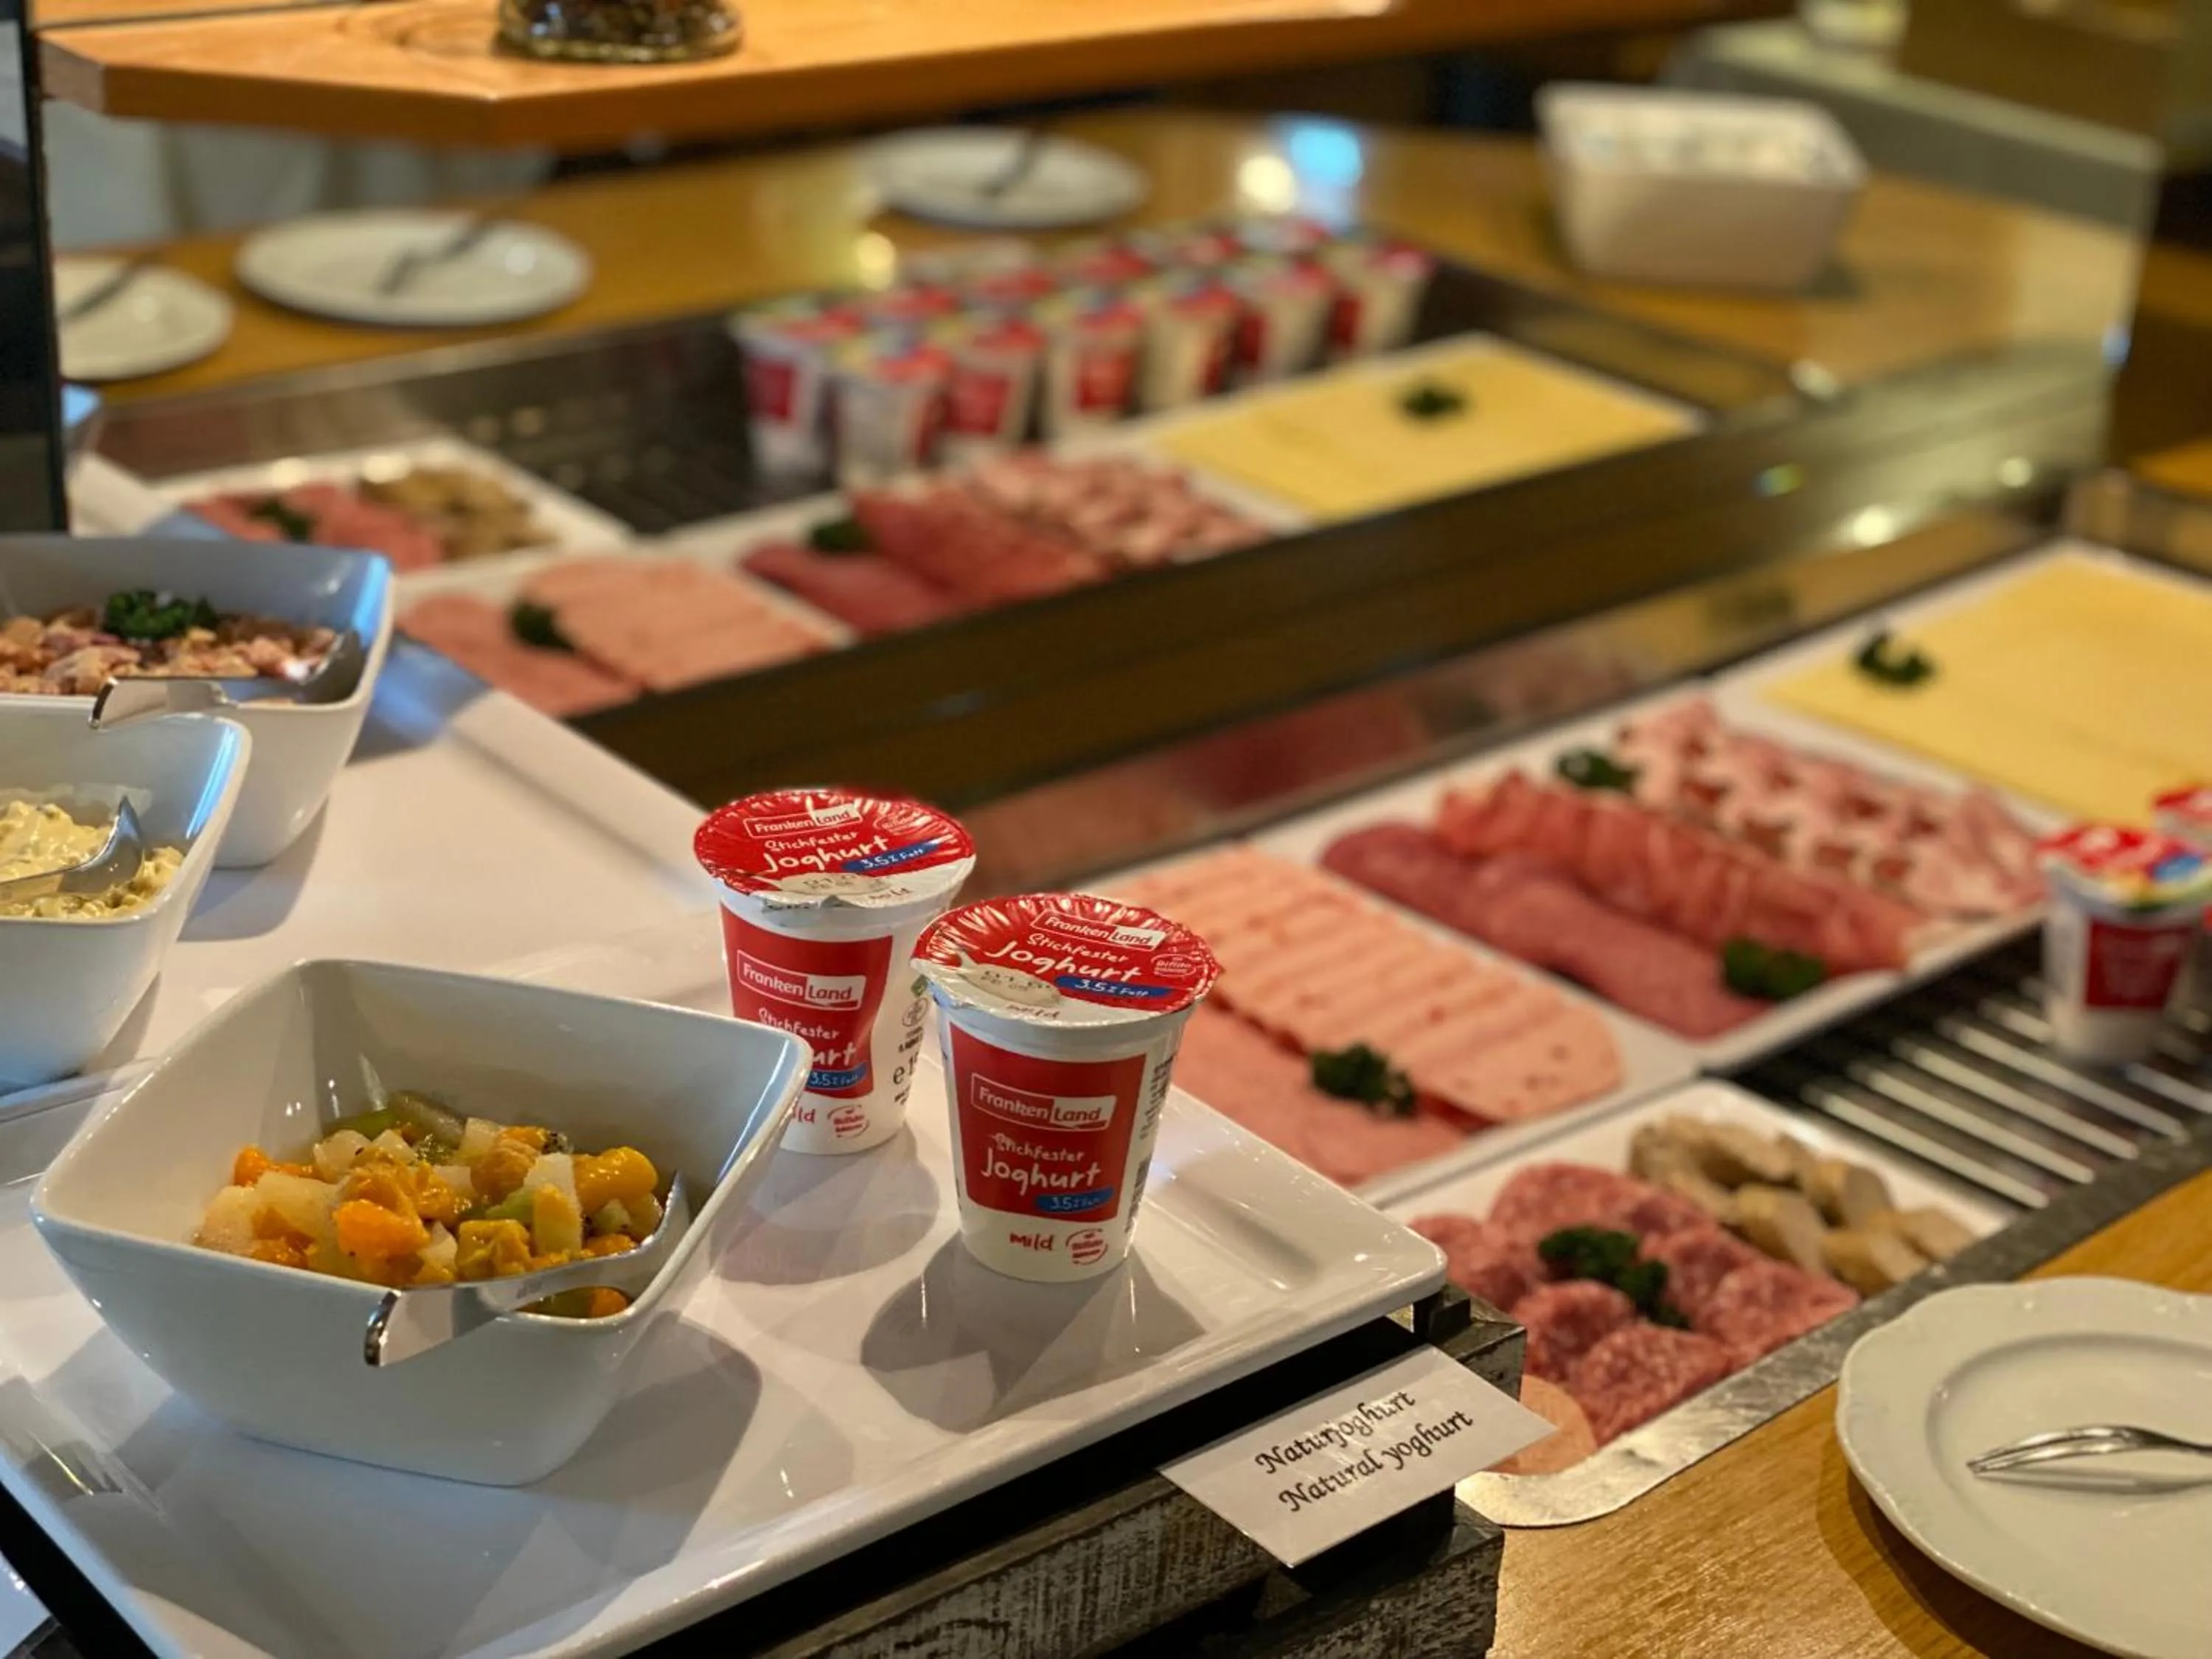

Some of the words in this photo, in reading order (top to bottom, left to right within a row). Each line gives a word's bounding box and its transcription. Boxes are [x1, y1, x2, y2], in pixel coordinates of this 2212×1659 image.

[762, 835, 889, 873] Joghurt
[765, 831, 859, 852] Stichfester
[984, 940, 1144, 982] Joghurt
[1026, 933, 1127, 964] Stichfester
[990, 1133, 1085, 1162] Stichfester
[981, 1147, 1102, 1197] Joghurt
[1009, 1231, 1054, 1251] mild
[1255, 1389, 1416, 1475] Naturjoghurt
[1278, 1448, 1384, 1513] Natural
[1380, 1409, 1474, 1471] yoghurt
